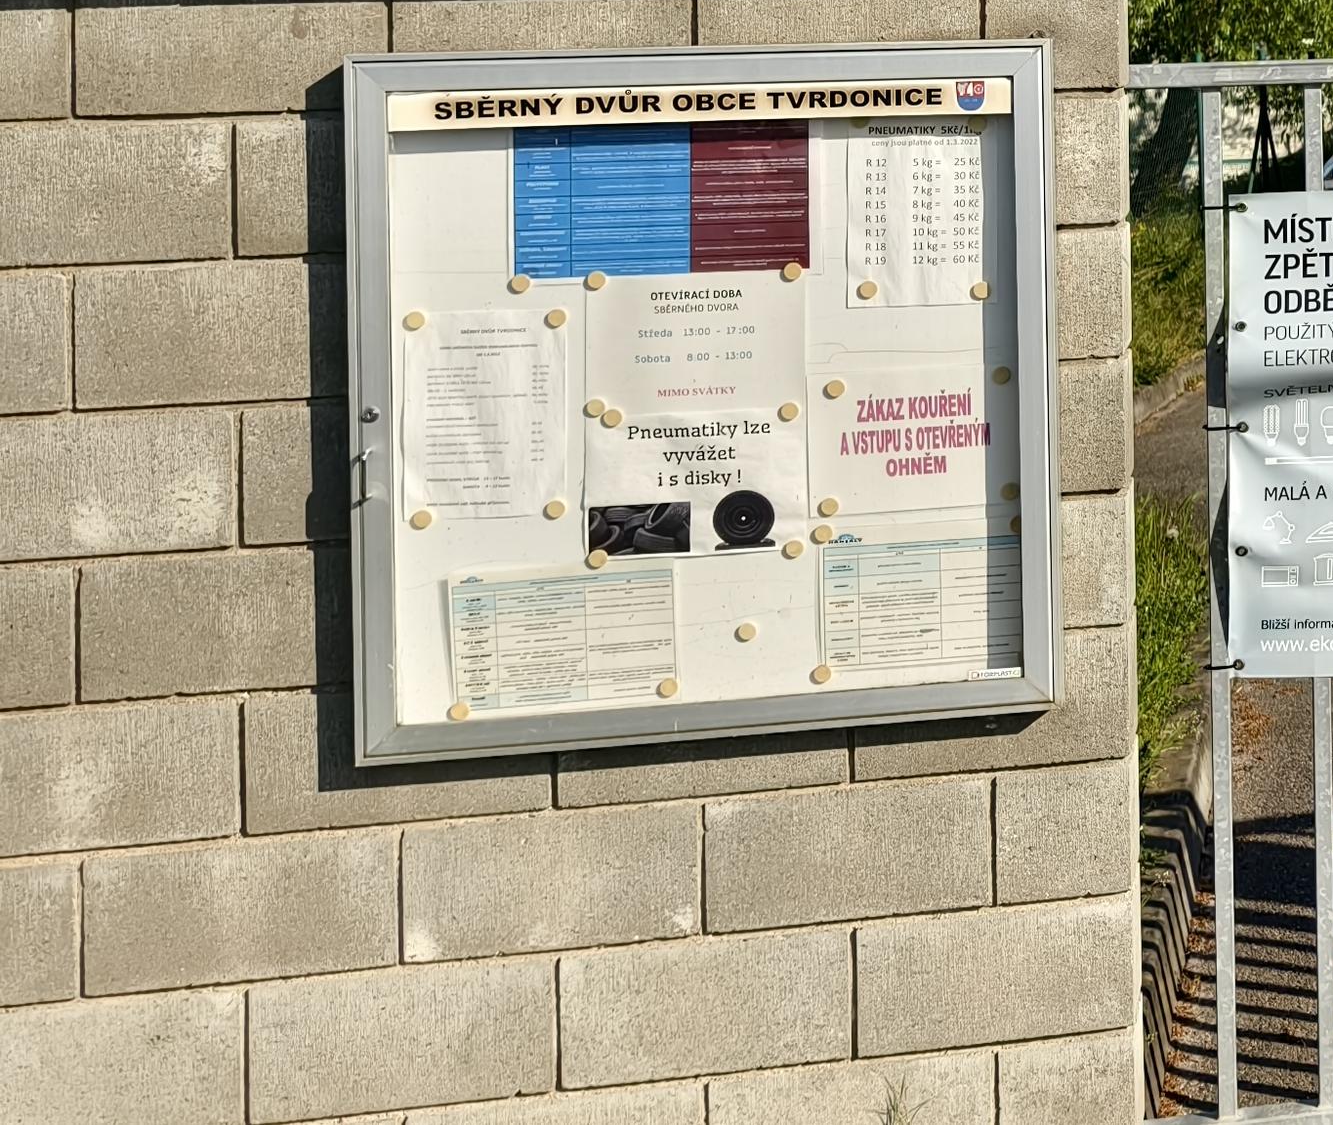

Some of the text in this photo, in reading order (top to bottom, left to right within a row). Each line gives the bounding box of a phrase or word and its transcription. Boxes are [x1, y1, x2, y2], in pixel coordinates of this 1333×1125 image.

[434, 87, 943, 120] SBĚRNÝ DVŮR OBCE TVRDONICE
[868, 125, 936, 136] PNEUMATIKY
[866, 157, 980, 169] R 12 5 kg 25 Kč
[866, 171, 980, 183] R 13 6 kg 30 Kč
[866, 185, 980, 197] R 14 7 kg 35 Kč
[866, 199, 980, 211] R 15 8 kg 40 Kč
[866, 213, 980, 225] R 16 9 kg 45 Kč
[866, 227, 980, 239] R 17 10 kg 50 Kč
[866, 240, 980, 252] R 18 11 kg 55 Kč
[866, 254, 980, 266] R 19 12 kg 60 Kč
[650, 289, 742, 301] OTEVÍRACÍ DOBA
[654, 303, 739, 314] SBĚRNÉHO DVORA
[638, 329, 673, 338] Středa
[683, 327, 710, 336] 13:00
[635, 355, 671, 363] Sobota
[725, 351, 752, 359] 13:00
[657, 386, 736, 397] MIMO SVÁTKY
[857, 387, 972, 422] ZÁKAZ KOUŘENÍ
[627, 421, 771, 439] Pneumatiky lze
[840, 418, 991, 455] A VSTUPU S OTEVŘENÝM
[663, 445, 736, 465] vyvážet
[886, 452, 947, 477] OHNĚM
[657, 470, 741, 486] i s disky !
[1264, 481, 1310, 501] MALÁ
[1315, 485, 1328, 500] A
[1261, 618, 1291, 630] Bližší
